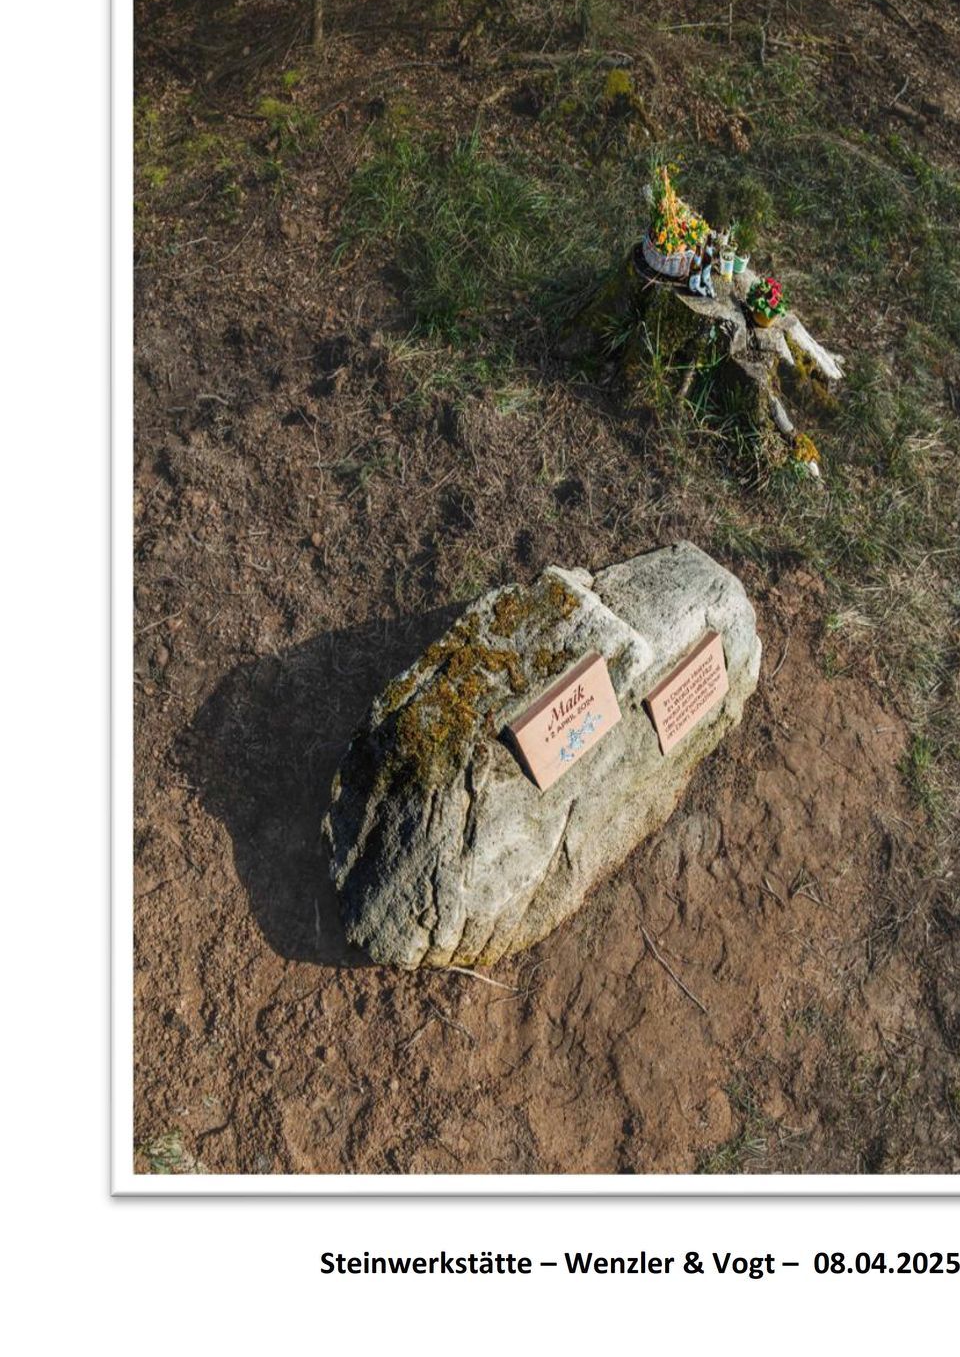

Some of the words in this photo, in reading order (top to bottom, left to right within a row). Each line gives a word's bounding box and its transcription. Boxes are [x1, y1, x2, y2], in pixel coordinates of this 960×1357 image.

[548, 684, 585, 732] Maik
[320, 1250, 534, 1275] Steinwerkstätte
[564, 1250, 676, 1275] Wenzler
[683, 1251, 706, 1275] &
[712, 1252, 776, 1280] Vogt
[813, 1251, 960, 1275] 08.04.2025
